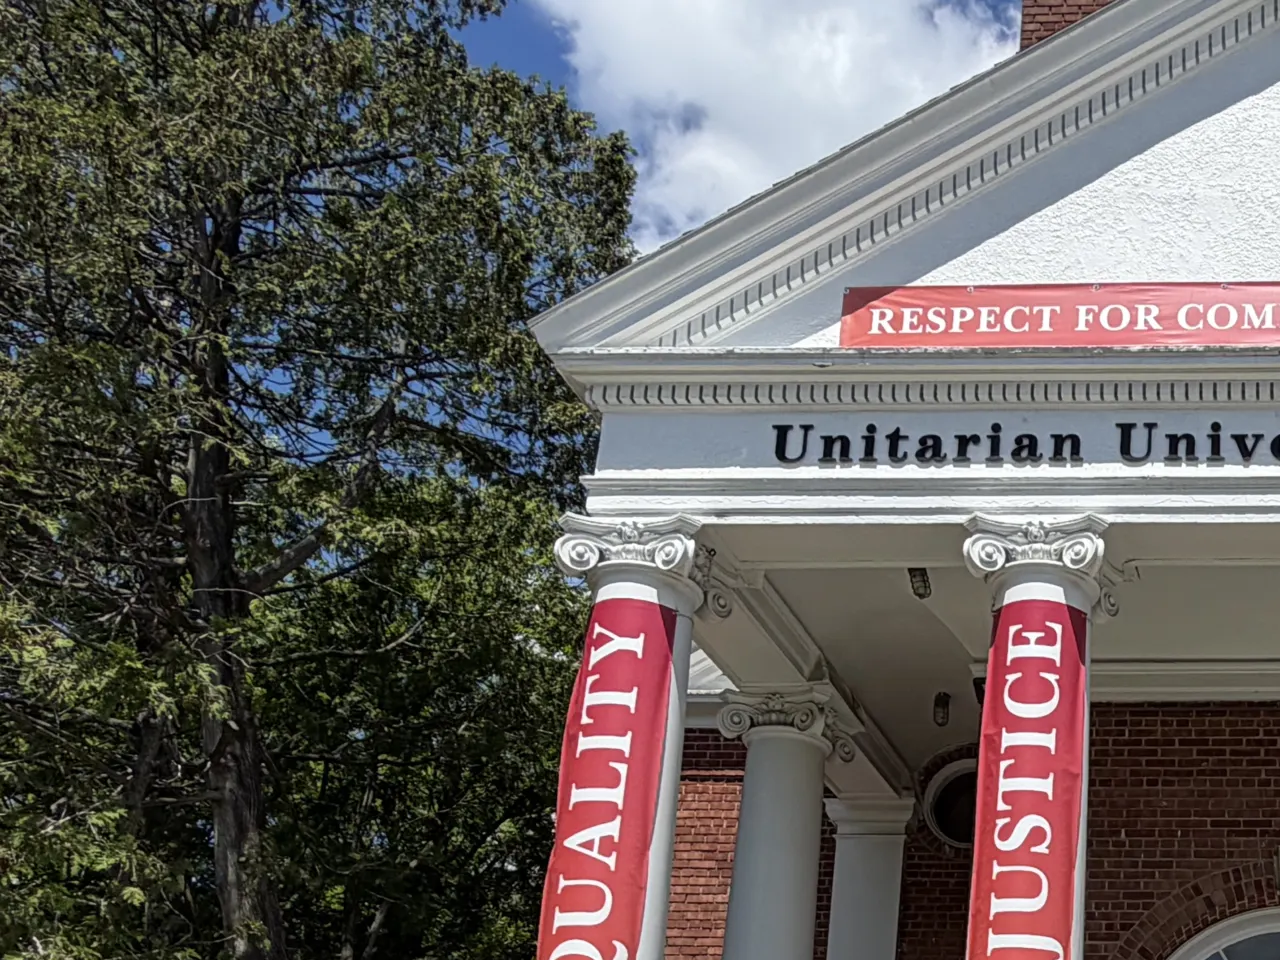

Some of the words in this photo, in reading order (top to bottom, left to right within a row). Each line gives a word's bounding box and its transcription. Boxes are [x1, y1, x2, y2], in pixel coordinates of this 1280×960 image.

[867, 305, 1061, 335] RESPECT
[1074, 302, 1164, 332] FOR
[773, 422, 1083, 465] Unitarian
